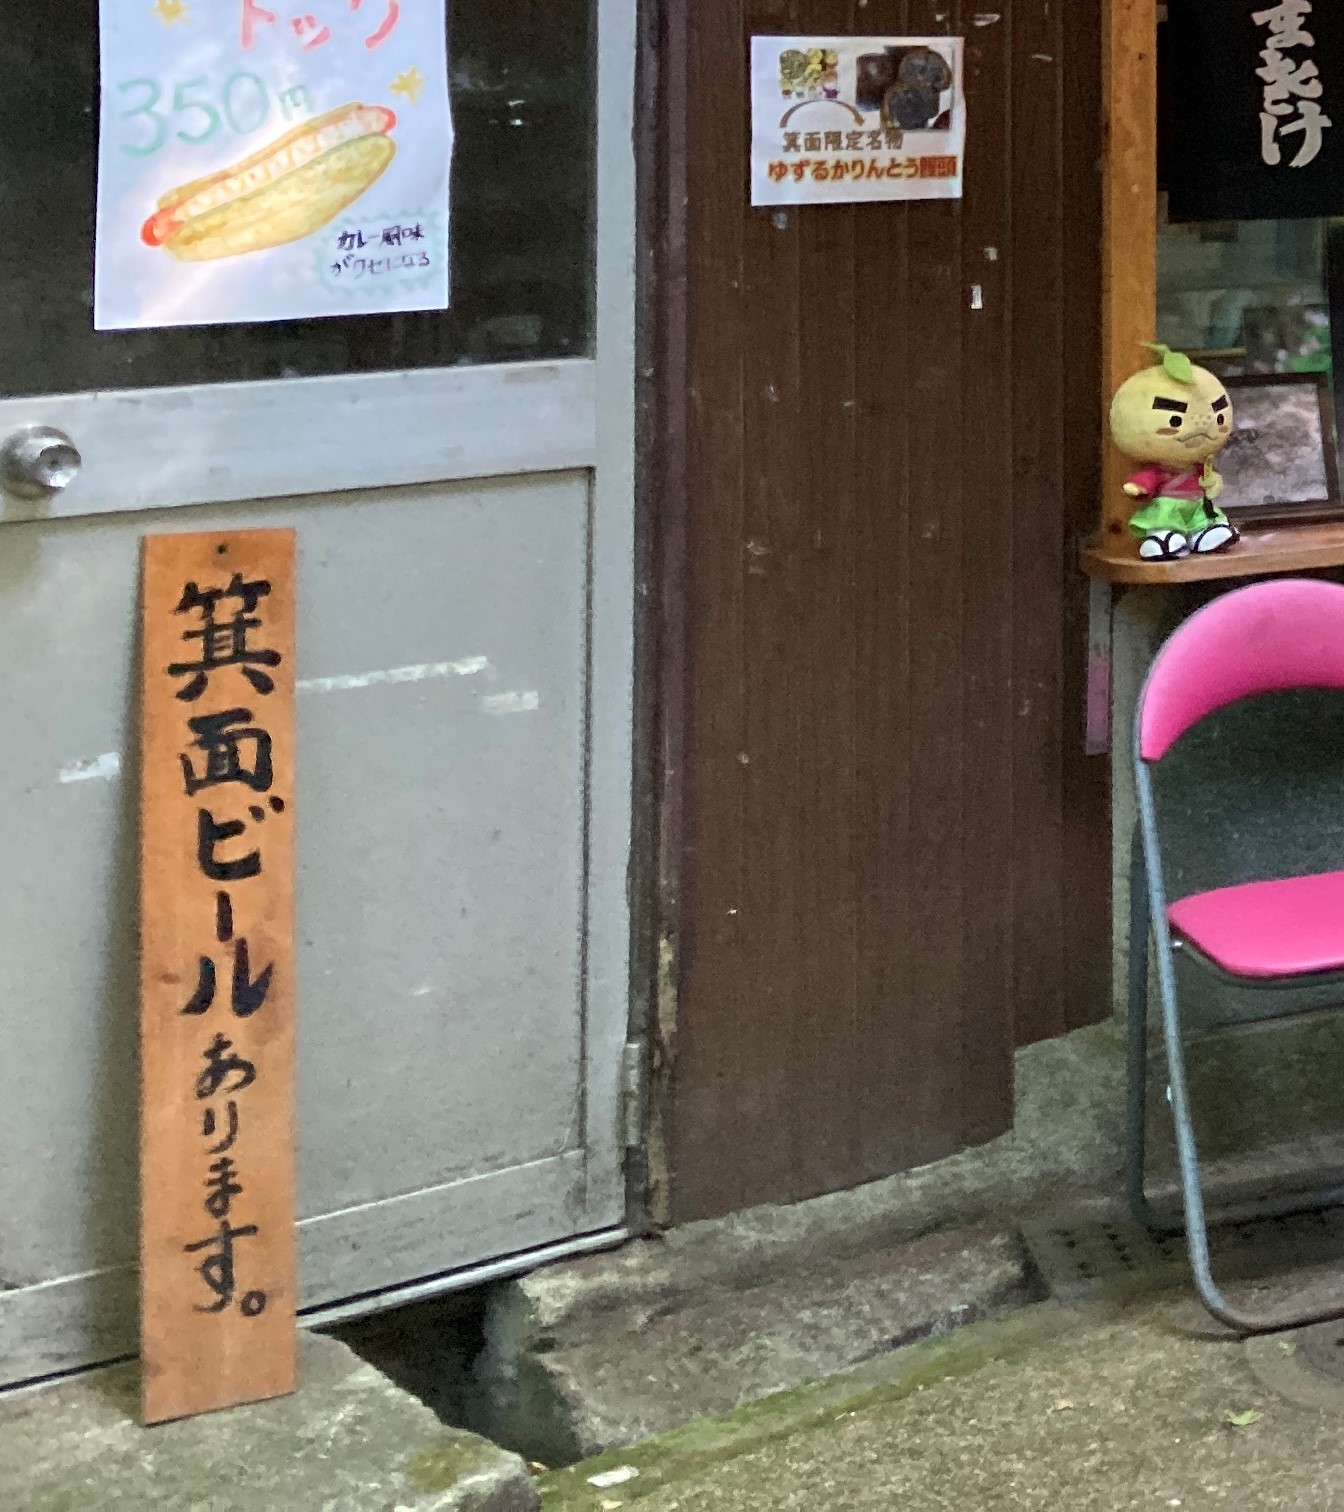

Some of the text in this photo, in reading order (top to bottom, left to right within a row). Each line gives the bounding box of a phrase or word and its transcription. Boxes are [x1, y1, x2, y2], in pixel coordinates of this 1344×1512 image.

[116, 71, 316, 158] 350円
[337, 222, 425, 251] カレー風味
[330, 251, 431, 280] がクセになる
